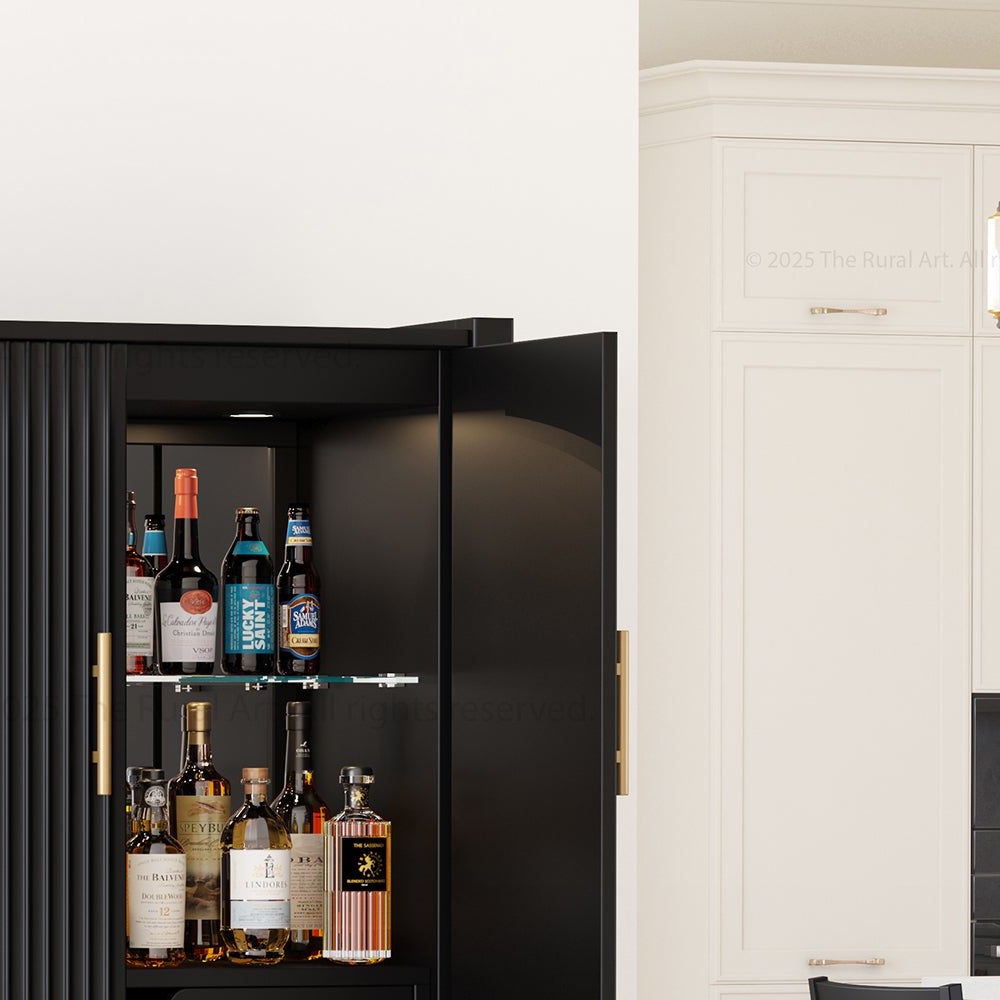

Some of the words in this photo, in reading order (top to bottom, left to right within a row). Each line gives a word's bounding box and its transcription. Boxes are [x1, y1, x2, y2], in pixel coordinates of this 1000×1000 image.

[293, 611, 318, 622] SAMUEL
[242, 598, 254, 650] LUCKY
[254, 599, 266, 650] SAINT
[294, 619, 318, 629] ADAMS
[172, 629, 201, 637] Christian
[158, 906, 170, 916] 12
